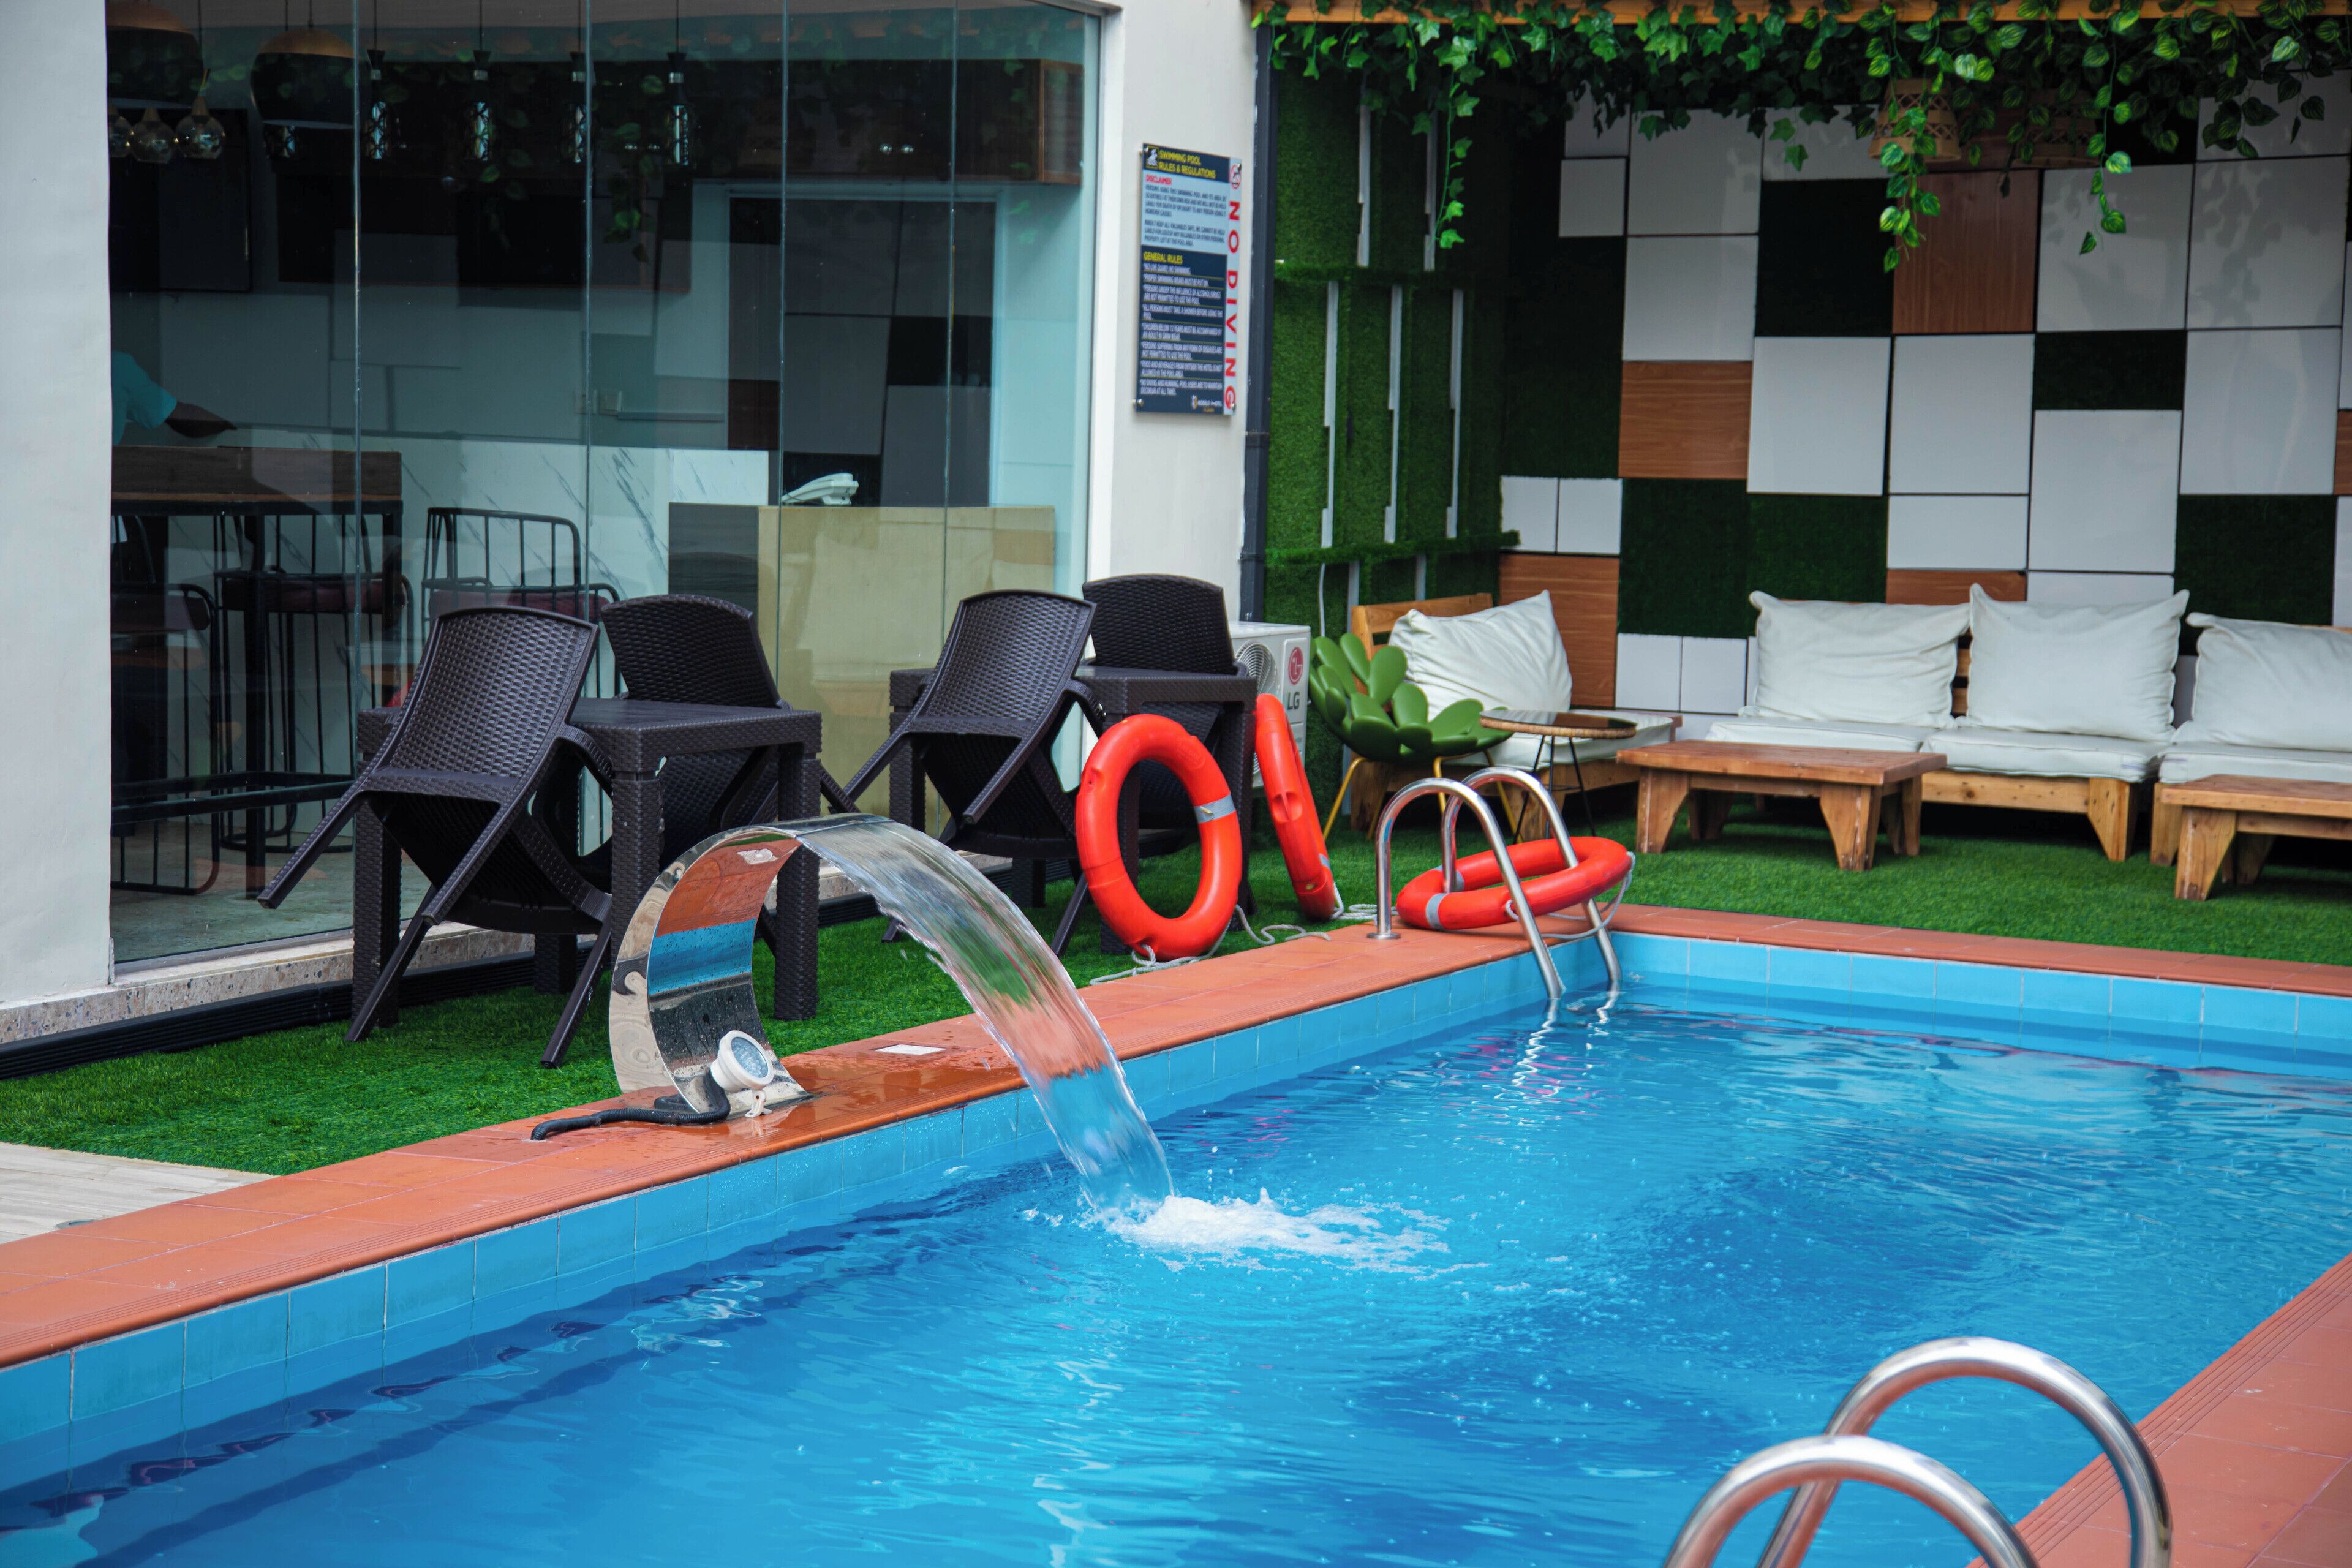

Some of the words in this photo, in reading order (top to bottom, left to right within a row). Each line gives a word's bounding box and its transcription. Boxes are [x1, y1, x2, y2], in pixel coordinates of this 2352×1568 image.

[1159, 150, 1186, 163] SWIMMING
[1188, 155, 1202, 165] POOL
[1159, 161, 1175, 172] RULES
[1182, 165, 1216, 178] REGULATIONS
[1229, 201, 1240, 253] NO
[1144, 252, 1166, 262] GENERAL
[1167, 254, 1183, 264] RULES
[1224, 271, 1238, 409] DIVING
[1287, 691, 1300, 710] LG
